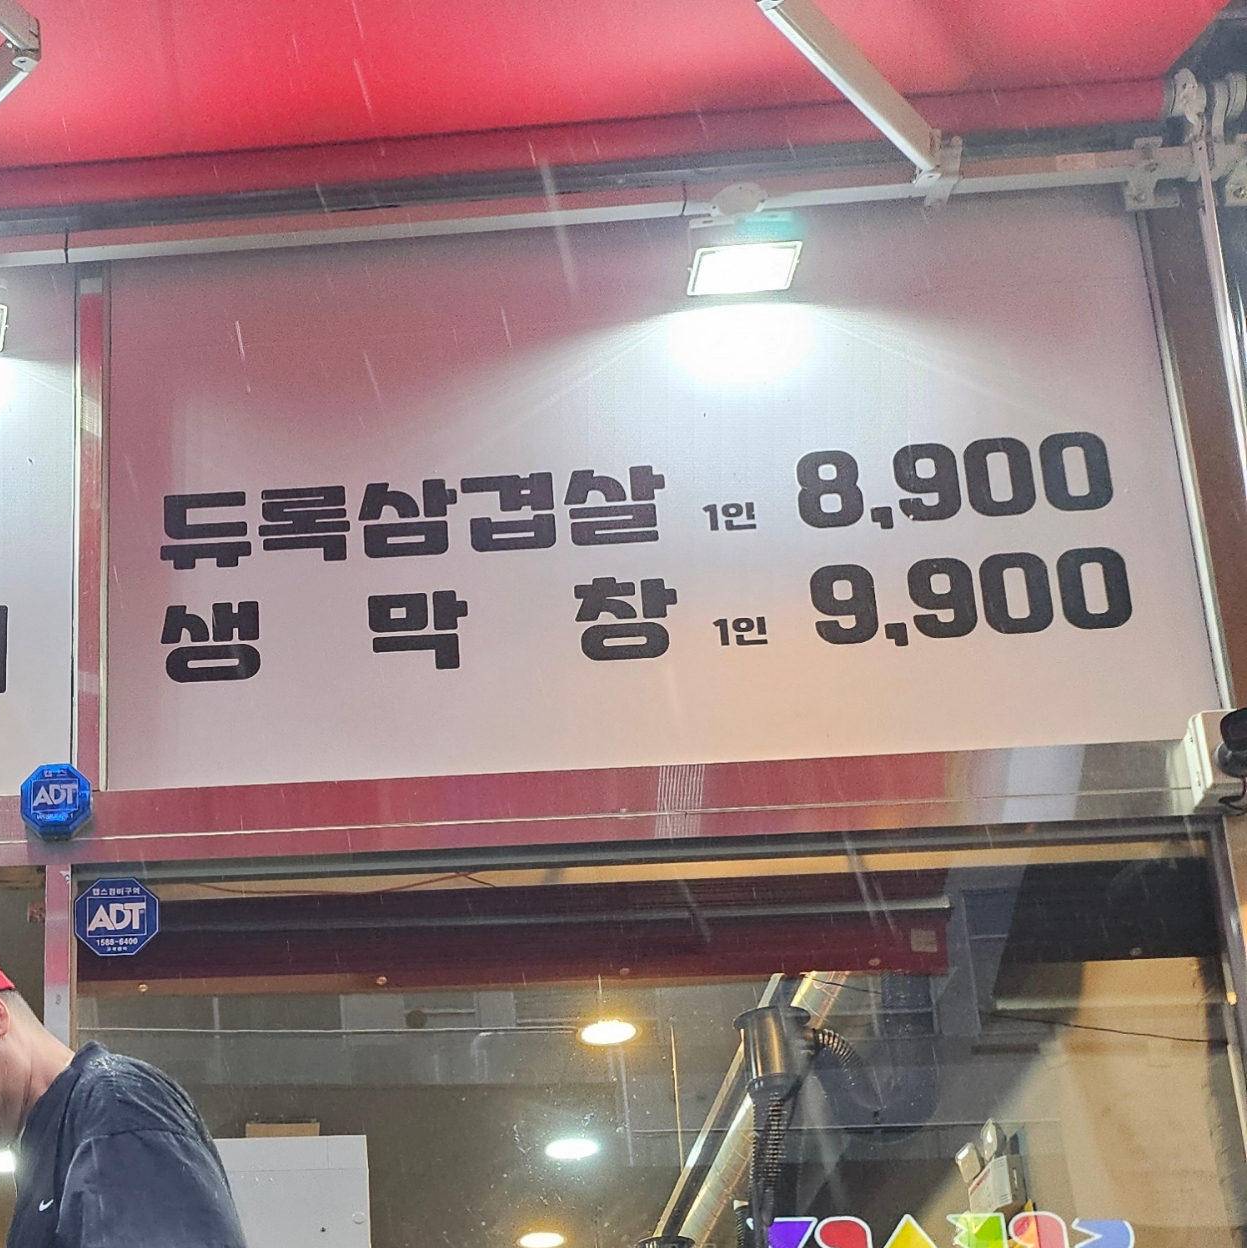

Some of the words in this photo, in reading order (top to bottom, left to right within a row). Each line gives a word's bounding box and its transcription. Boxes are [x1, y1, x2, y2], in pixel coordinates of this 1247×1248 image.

[160, 466, 666, 570] 듀록삼겹살
[702, 502, 757, 531] 1인
[798, 432, 1114, 529] 8,900
[712, 616, 769, 646] 1인
[810, 547, 1133, 647] 9,900
[32, 783, 78, 807] ADT
[87, 902, 146, 931] ADT
[96, 937, 138, 946] 1588-6400
